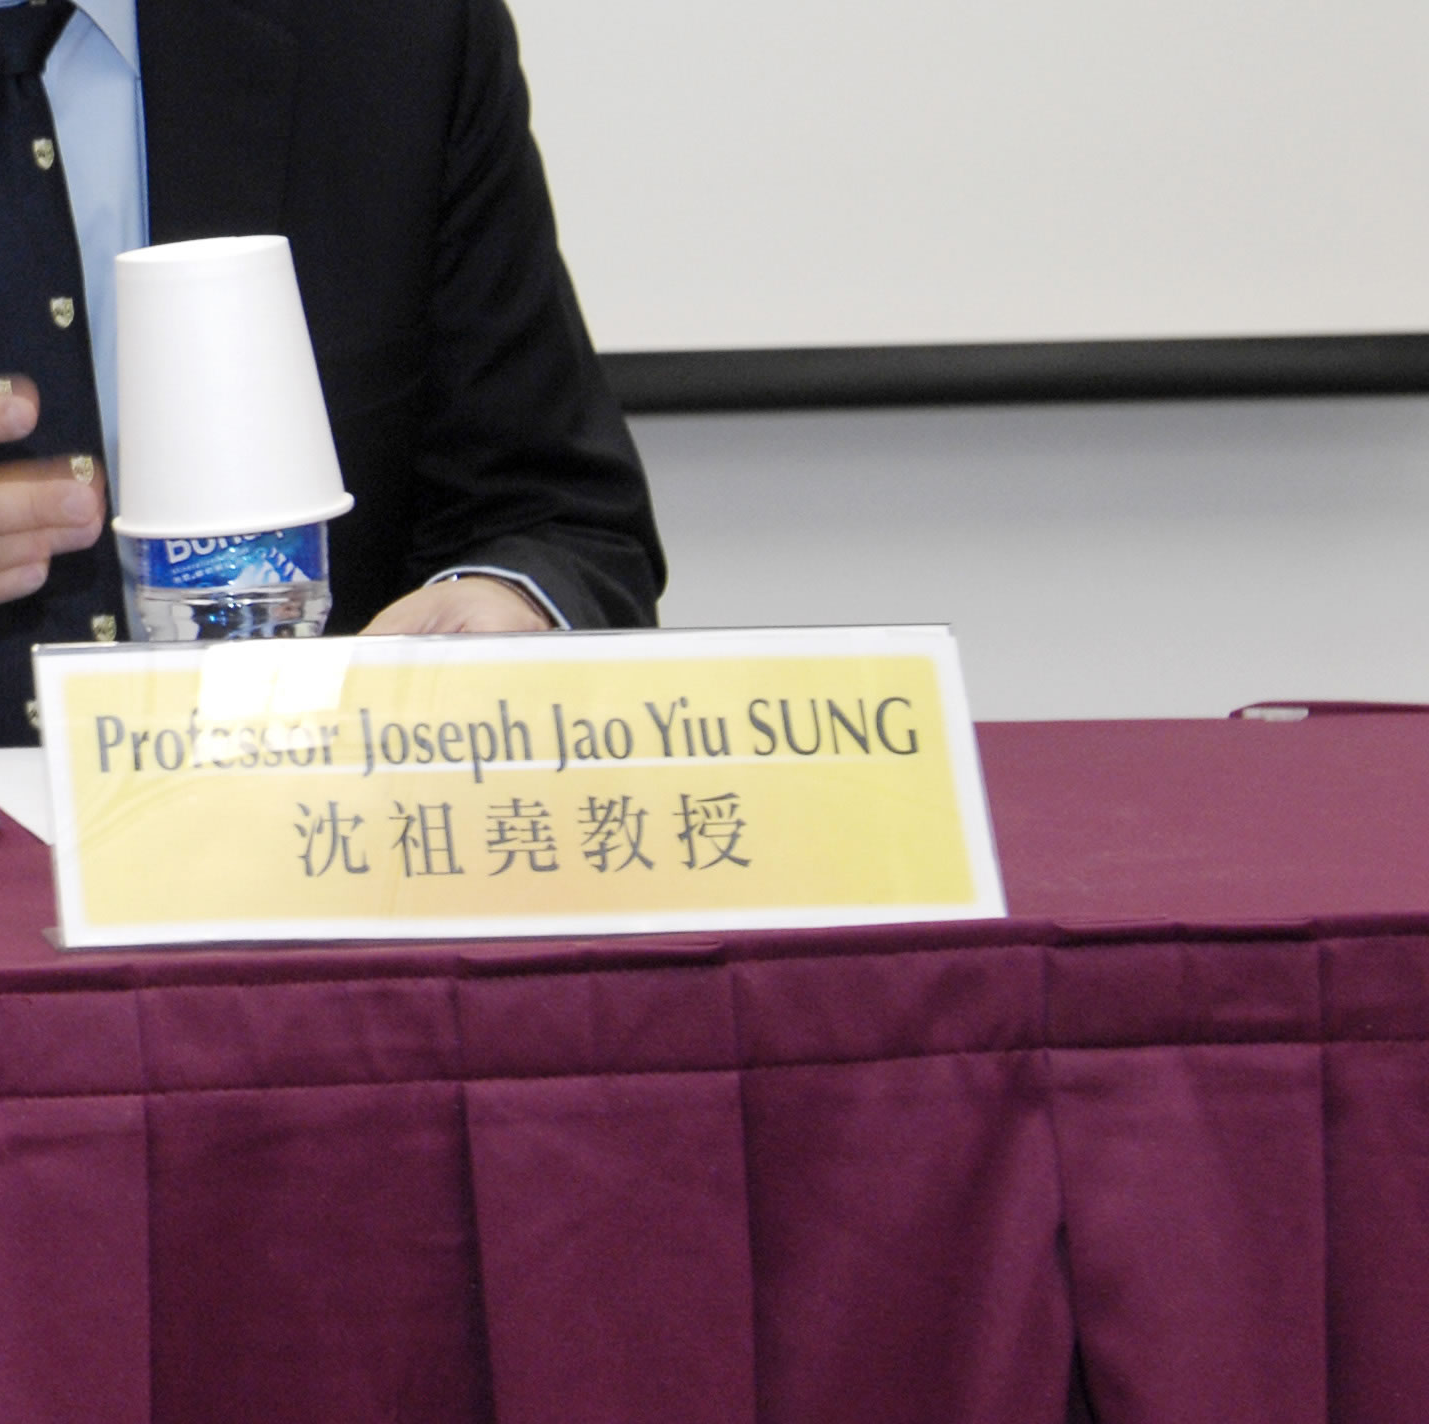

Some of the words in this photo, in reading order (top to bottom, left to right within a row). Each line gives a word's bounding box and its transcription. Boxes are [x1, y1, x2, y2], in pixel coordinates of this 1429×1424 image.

[95, 707, 339, 774] Professor
[359, 698, 533, 784] Joseph
[552, 702, 634, 772] Jao
[643, 696, 731, 758] Yiu
[748, 696, 920, 757] SUNG
[293, 792, 752, 879] 沈祖堯教授
